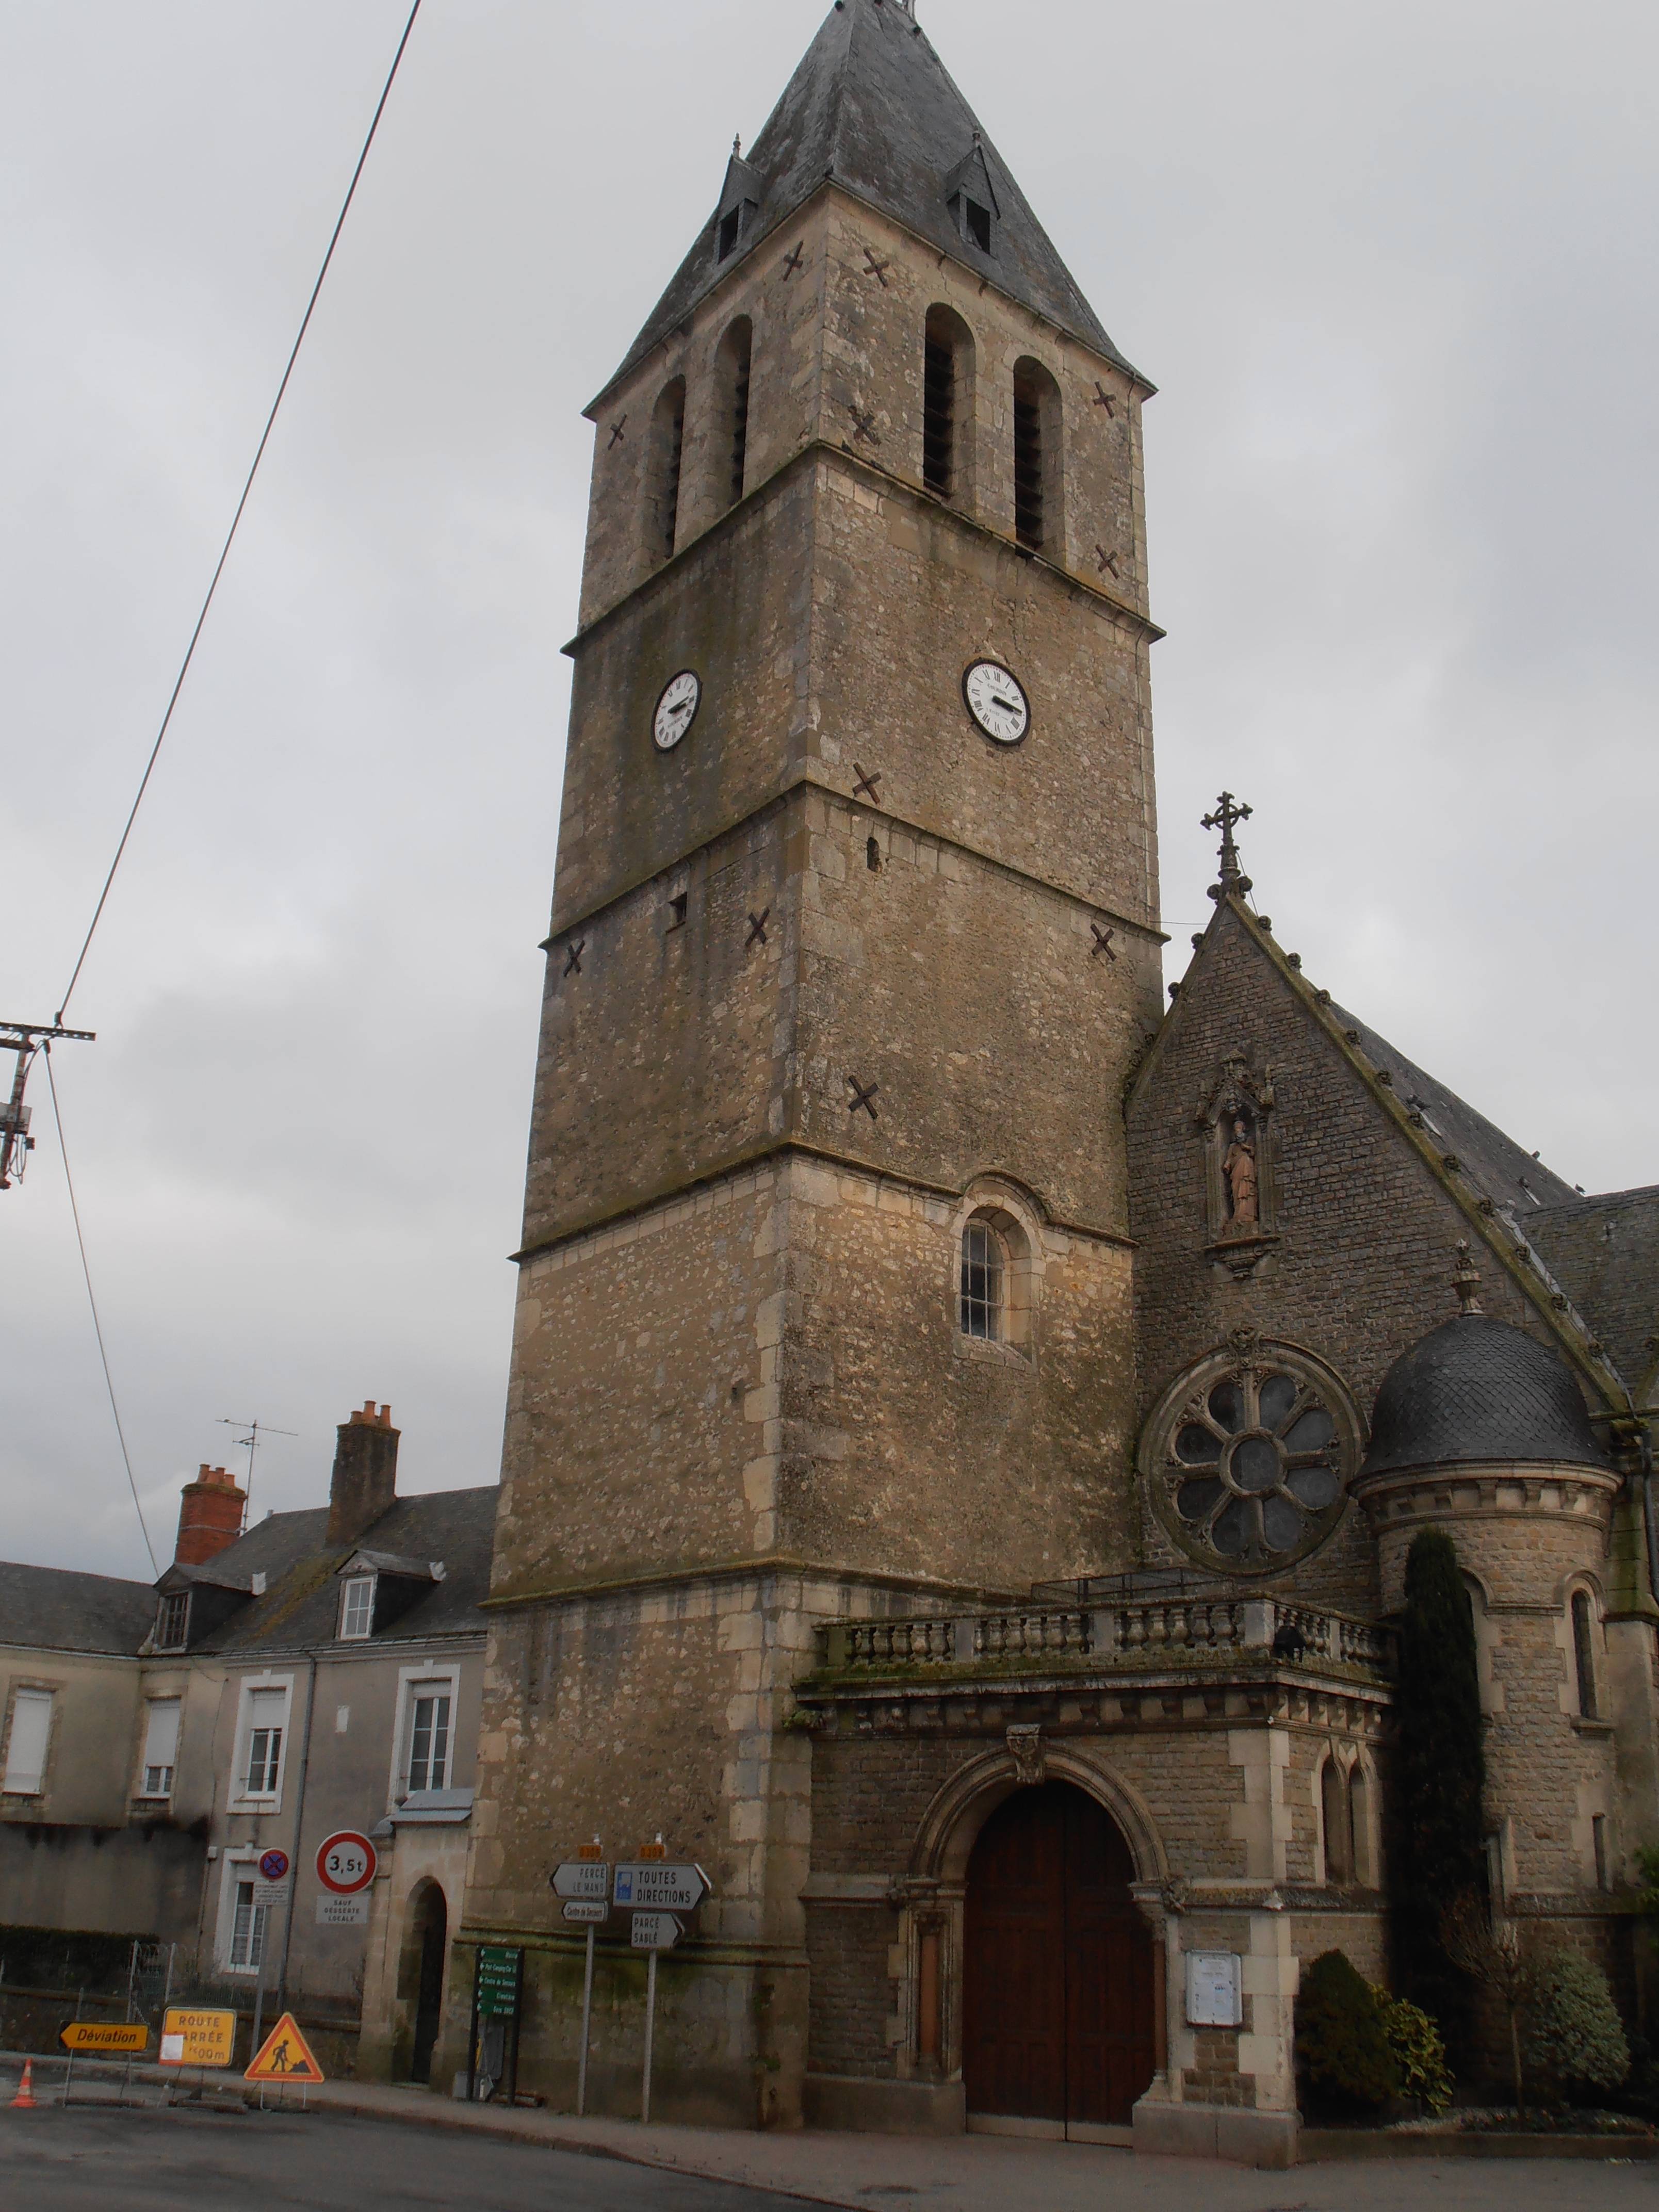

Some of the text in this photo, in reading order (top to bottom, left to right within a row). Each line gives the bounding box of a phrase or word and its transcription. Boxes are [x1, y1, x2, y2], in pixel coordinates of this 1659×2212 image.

[638, 1871, 677, 1885] TOUTES
[573, 1881, 604, 1893] LE MANS
[637, 1889, 691, 1904] DIRECTIONS
[634, 1916, 660, 1929] PARCÉ
[633, 1932, 658, 1944] SABLÉ
[178, 2015, 220, 2027] ROUTE
[77, 2028, 137, 2042] Déviation
[174, 2030, 223, 2043] ARRÉE
